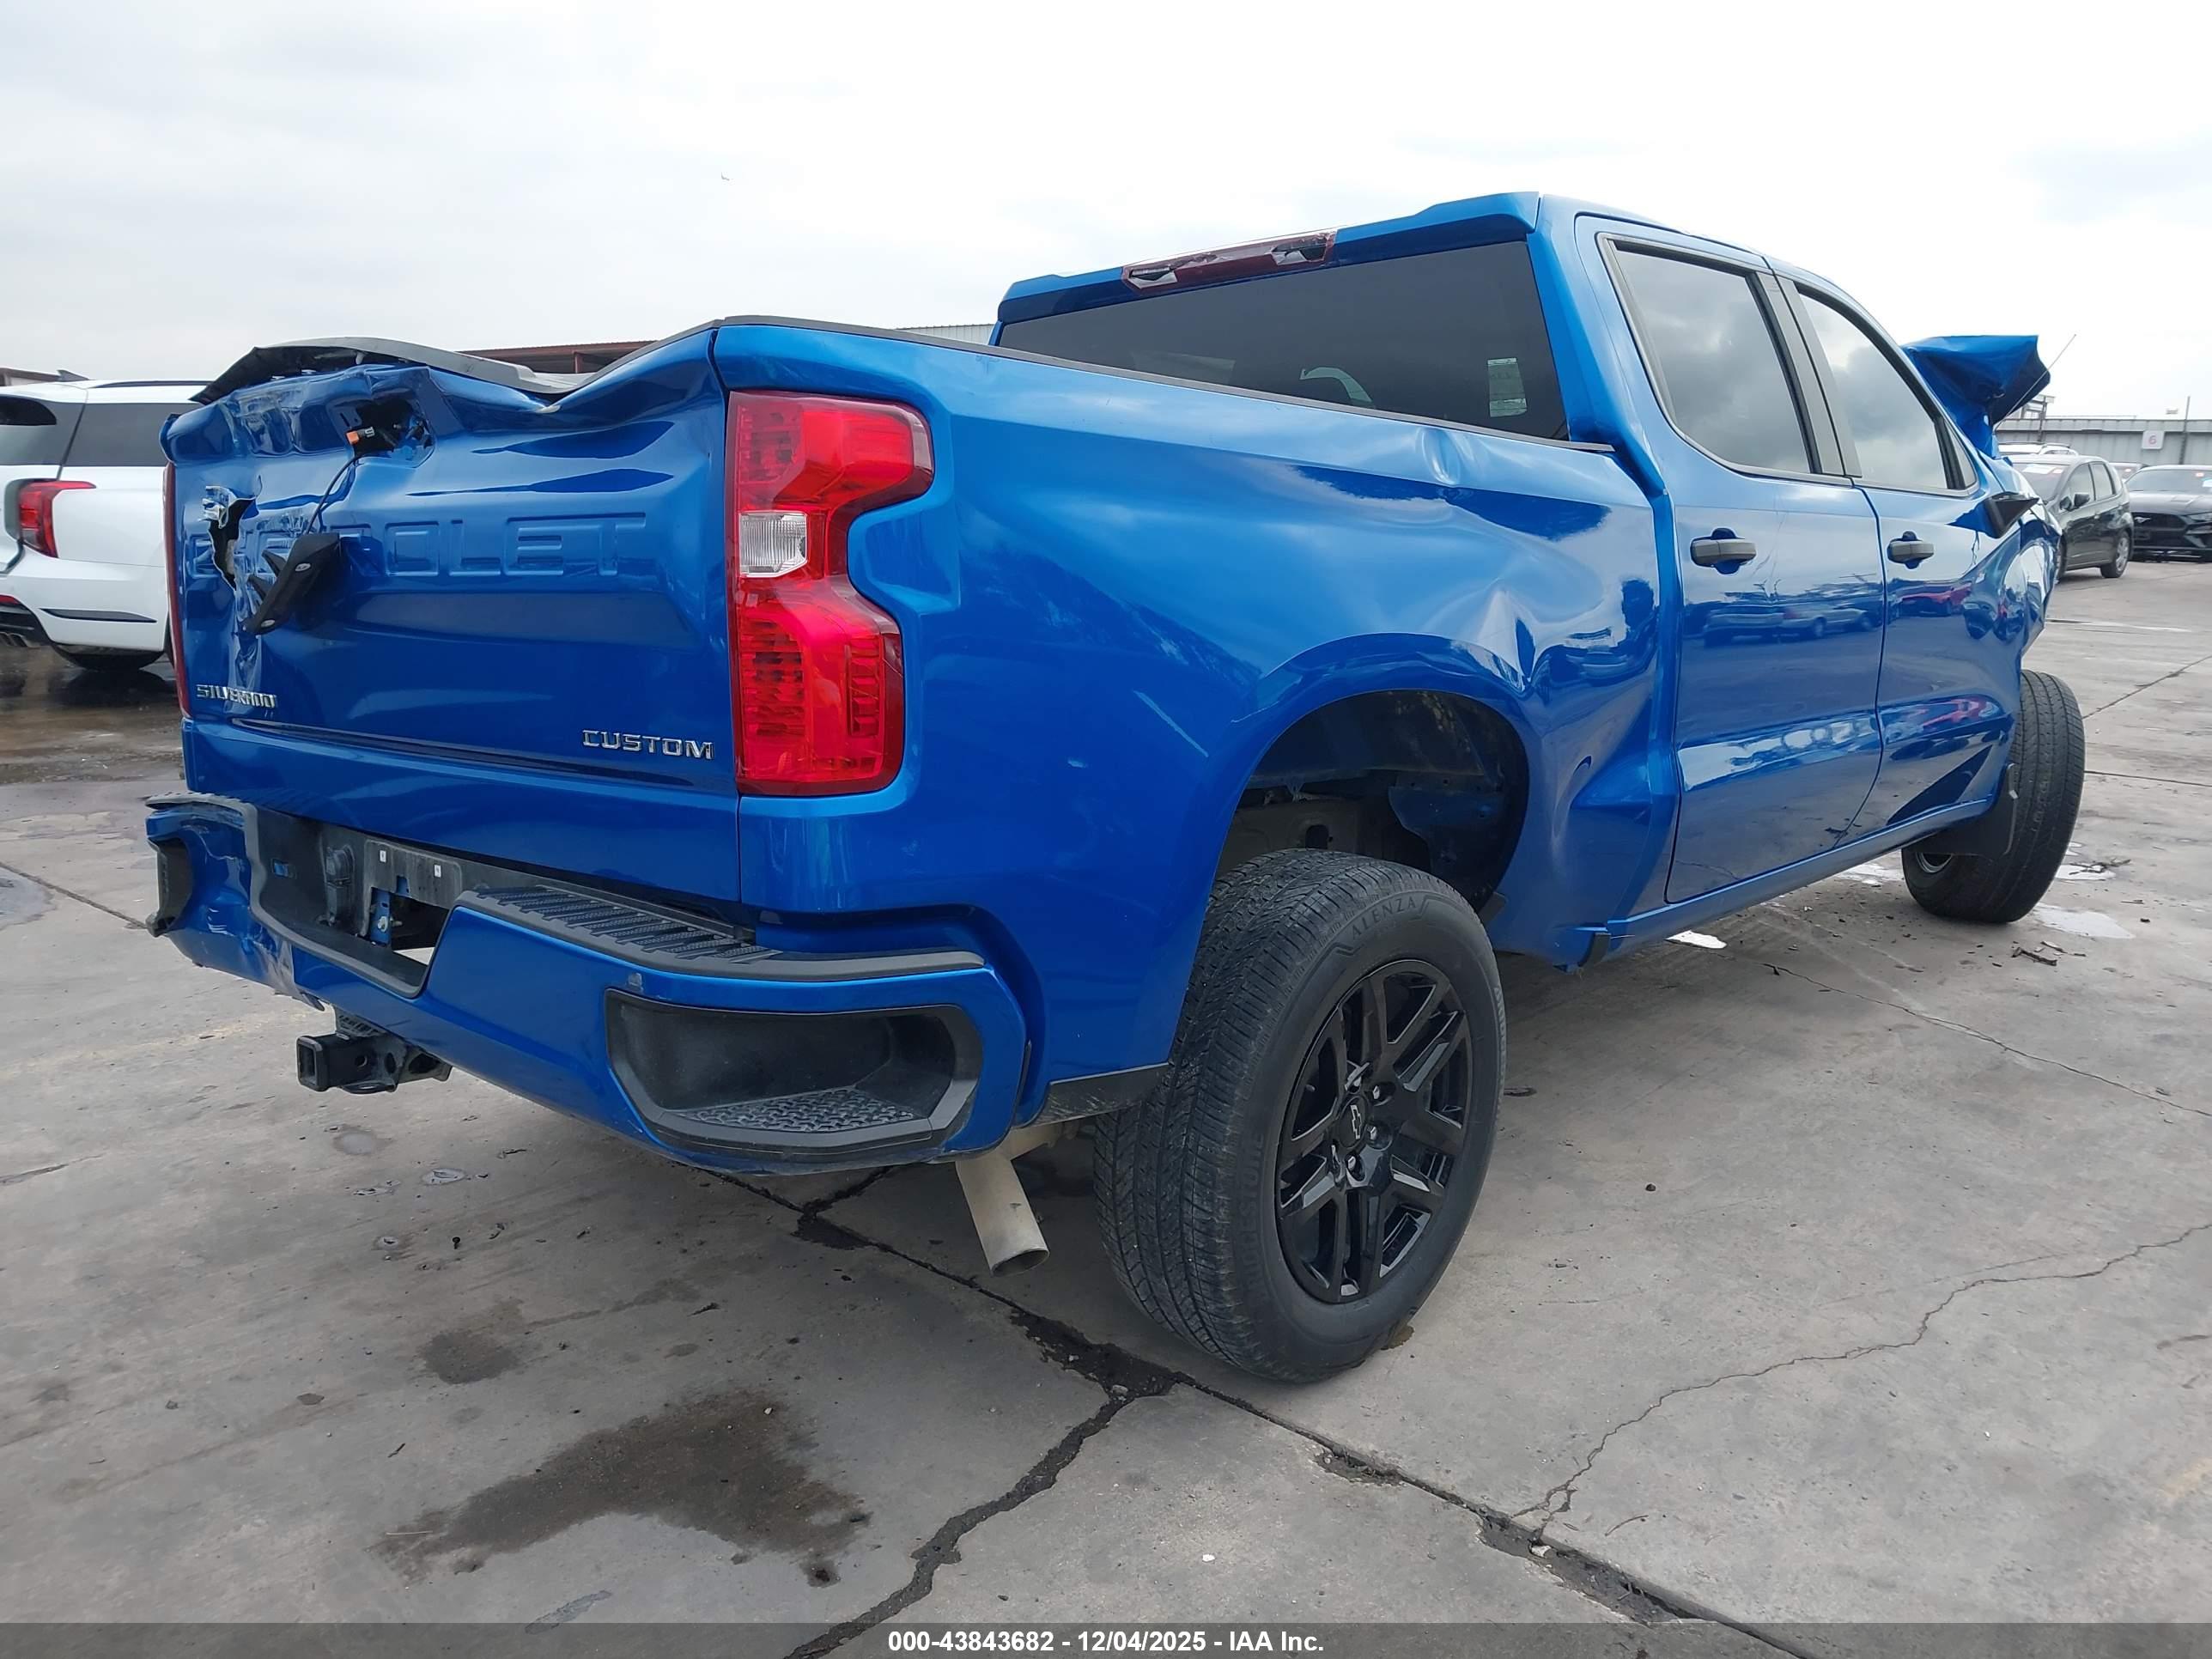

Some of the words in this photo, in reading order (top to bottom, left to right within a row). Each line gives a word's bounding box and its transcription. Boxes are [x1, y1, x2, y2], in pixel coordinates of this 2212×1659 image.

[2148, 434, 2157, 445] 6
[582, 729, 715, 760] CUSTOM
[1352, 896, 1417, 940] ALENZA
